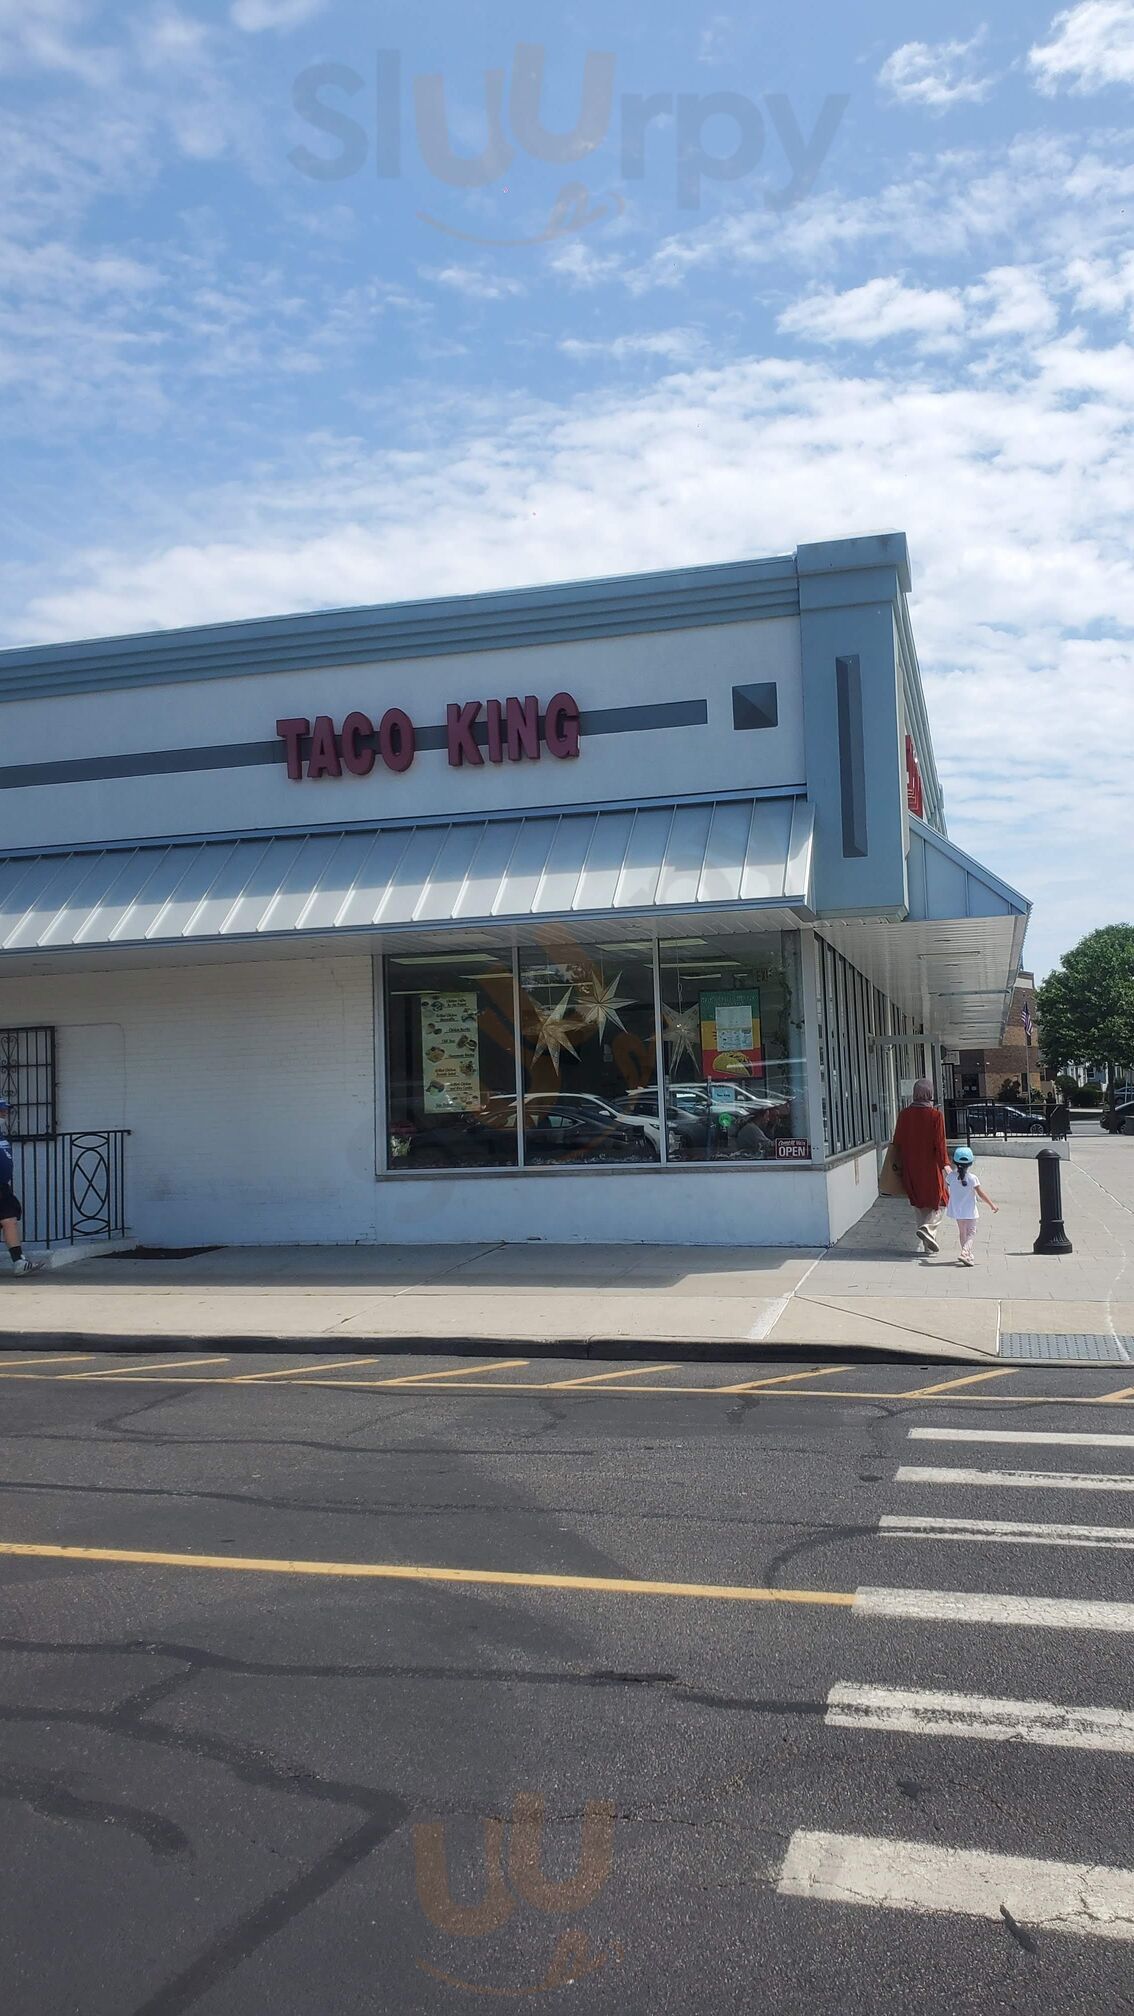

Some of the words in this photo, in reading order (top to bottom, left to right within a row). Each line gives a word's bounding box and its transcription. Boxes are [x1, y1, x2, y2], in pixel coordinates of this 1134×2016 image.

[276, 708, 415, 780] TACO
[446, 691, 580, 768] KING
[778, 1146, 806, 1157] OPEN
